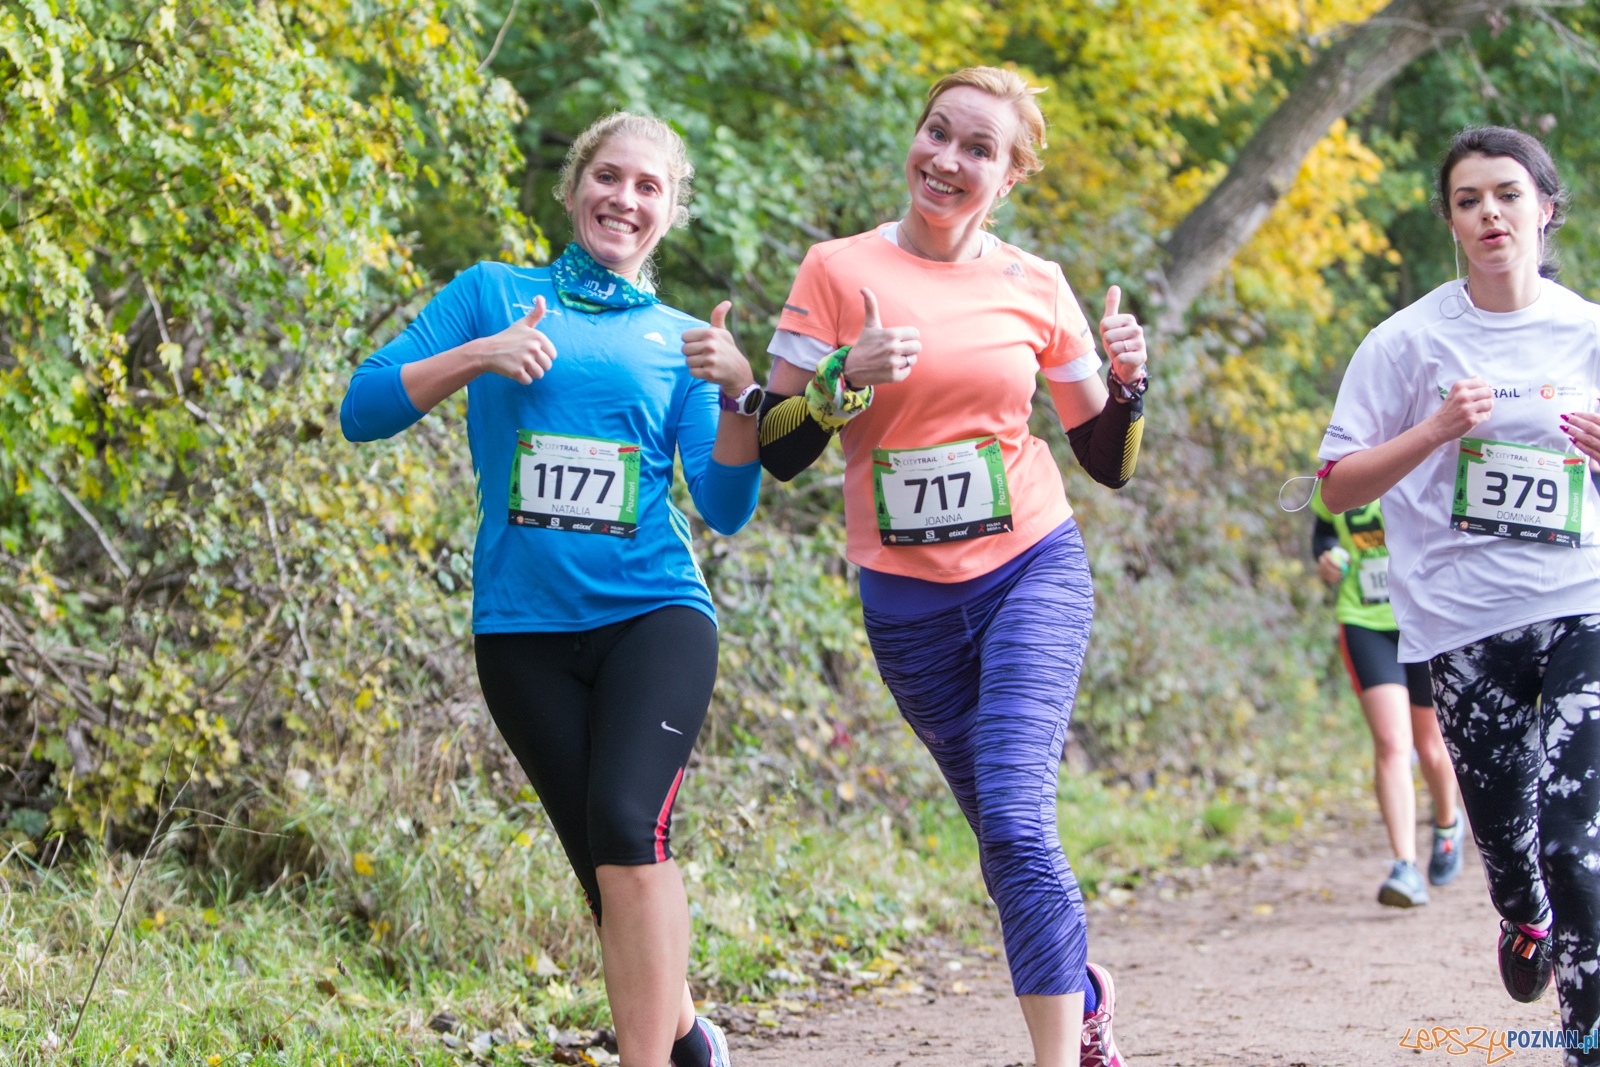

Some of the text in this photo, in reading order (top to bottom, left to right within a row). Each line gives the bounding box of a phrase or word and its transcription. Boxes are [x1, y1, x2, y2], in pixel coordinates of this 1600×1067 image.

[534, 463, 616, 504] 1177
[904, 471, 972, 514] 717
[1482, 471, 1558, 513] 379
[551, 504, 591, 516] NATALIA
[925, 513, 963, 526] JOANNA
[1496, 510, 1541, 525] DOMINIKA
